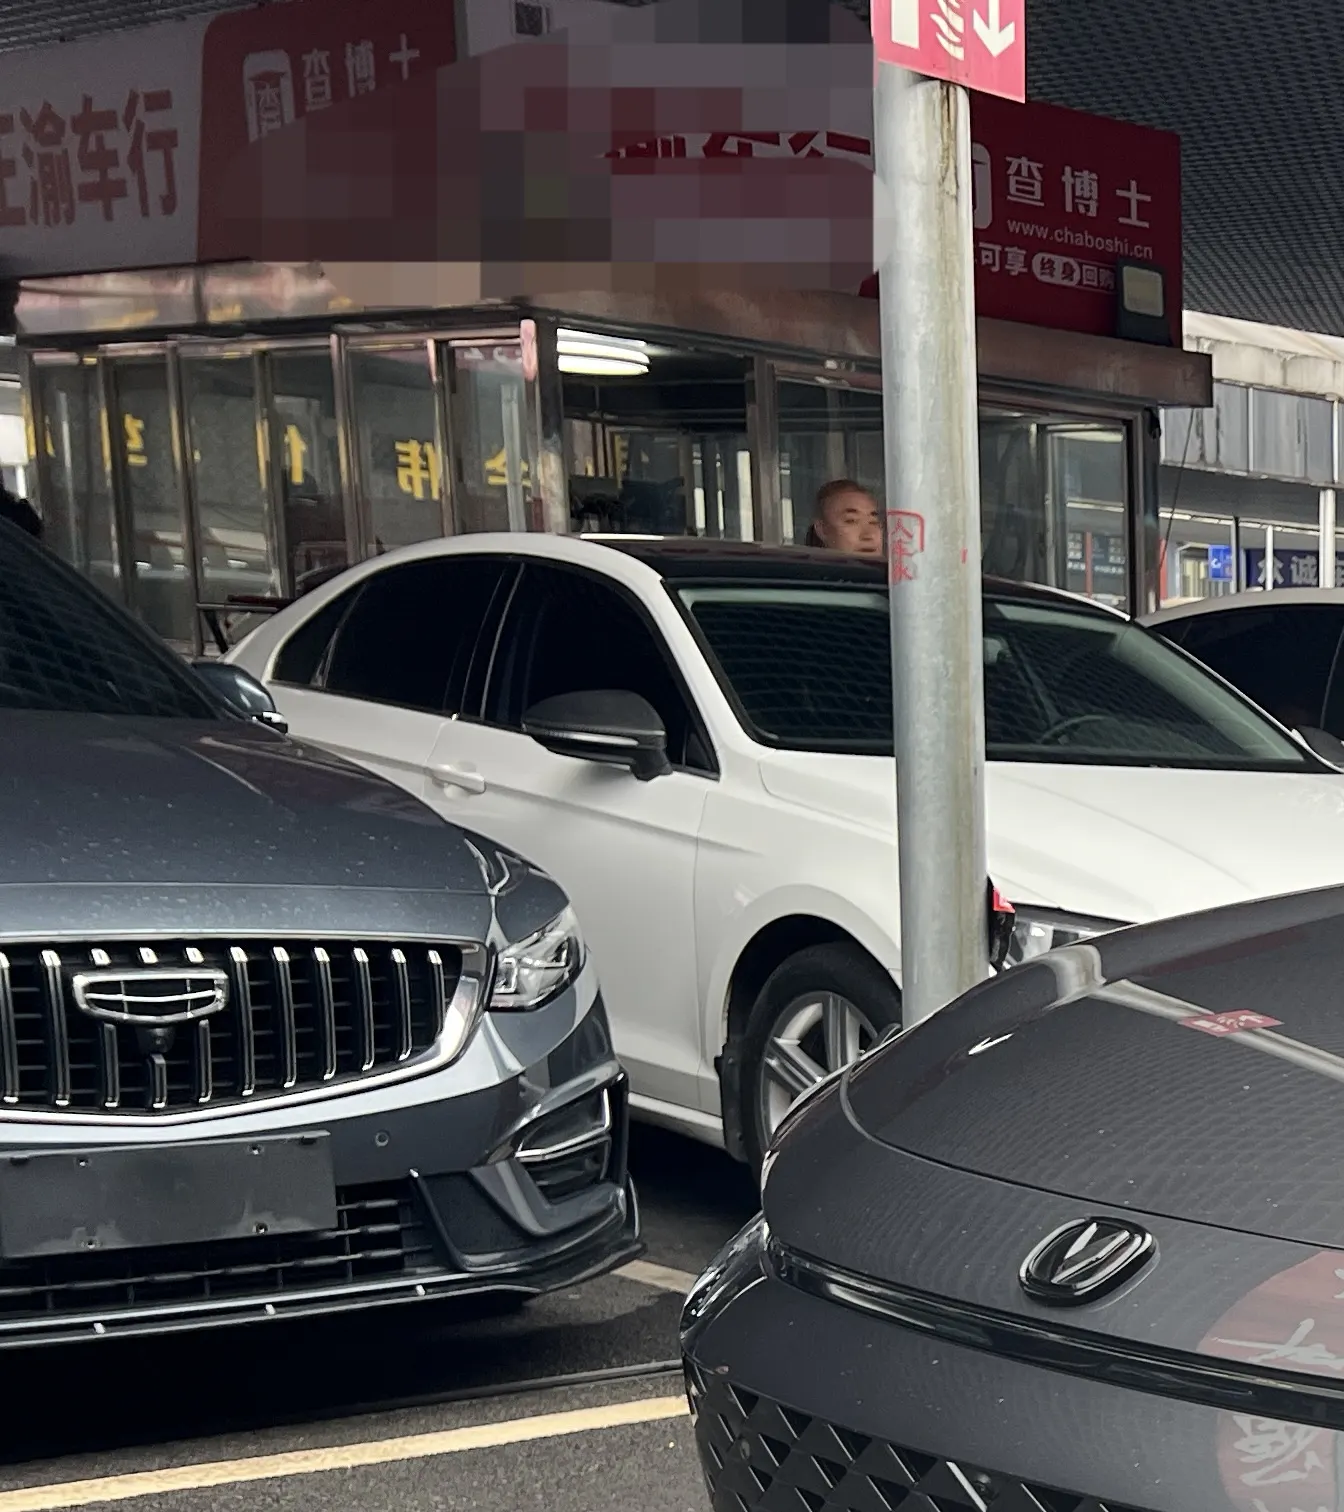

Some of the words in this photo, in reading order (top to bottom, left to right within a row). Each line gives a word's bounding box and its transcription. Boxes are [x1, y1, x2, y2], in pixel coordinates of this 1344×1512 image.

[1005, 156, 1152, 228] 查博士
[1006, 219, 1153, 260] www.chaboshi.cn
